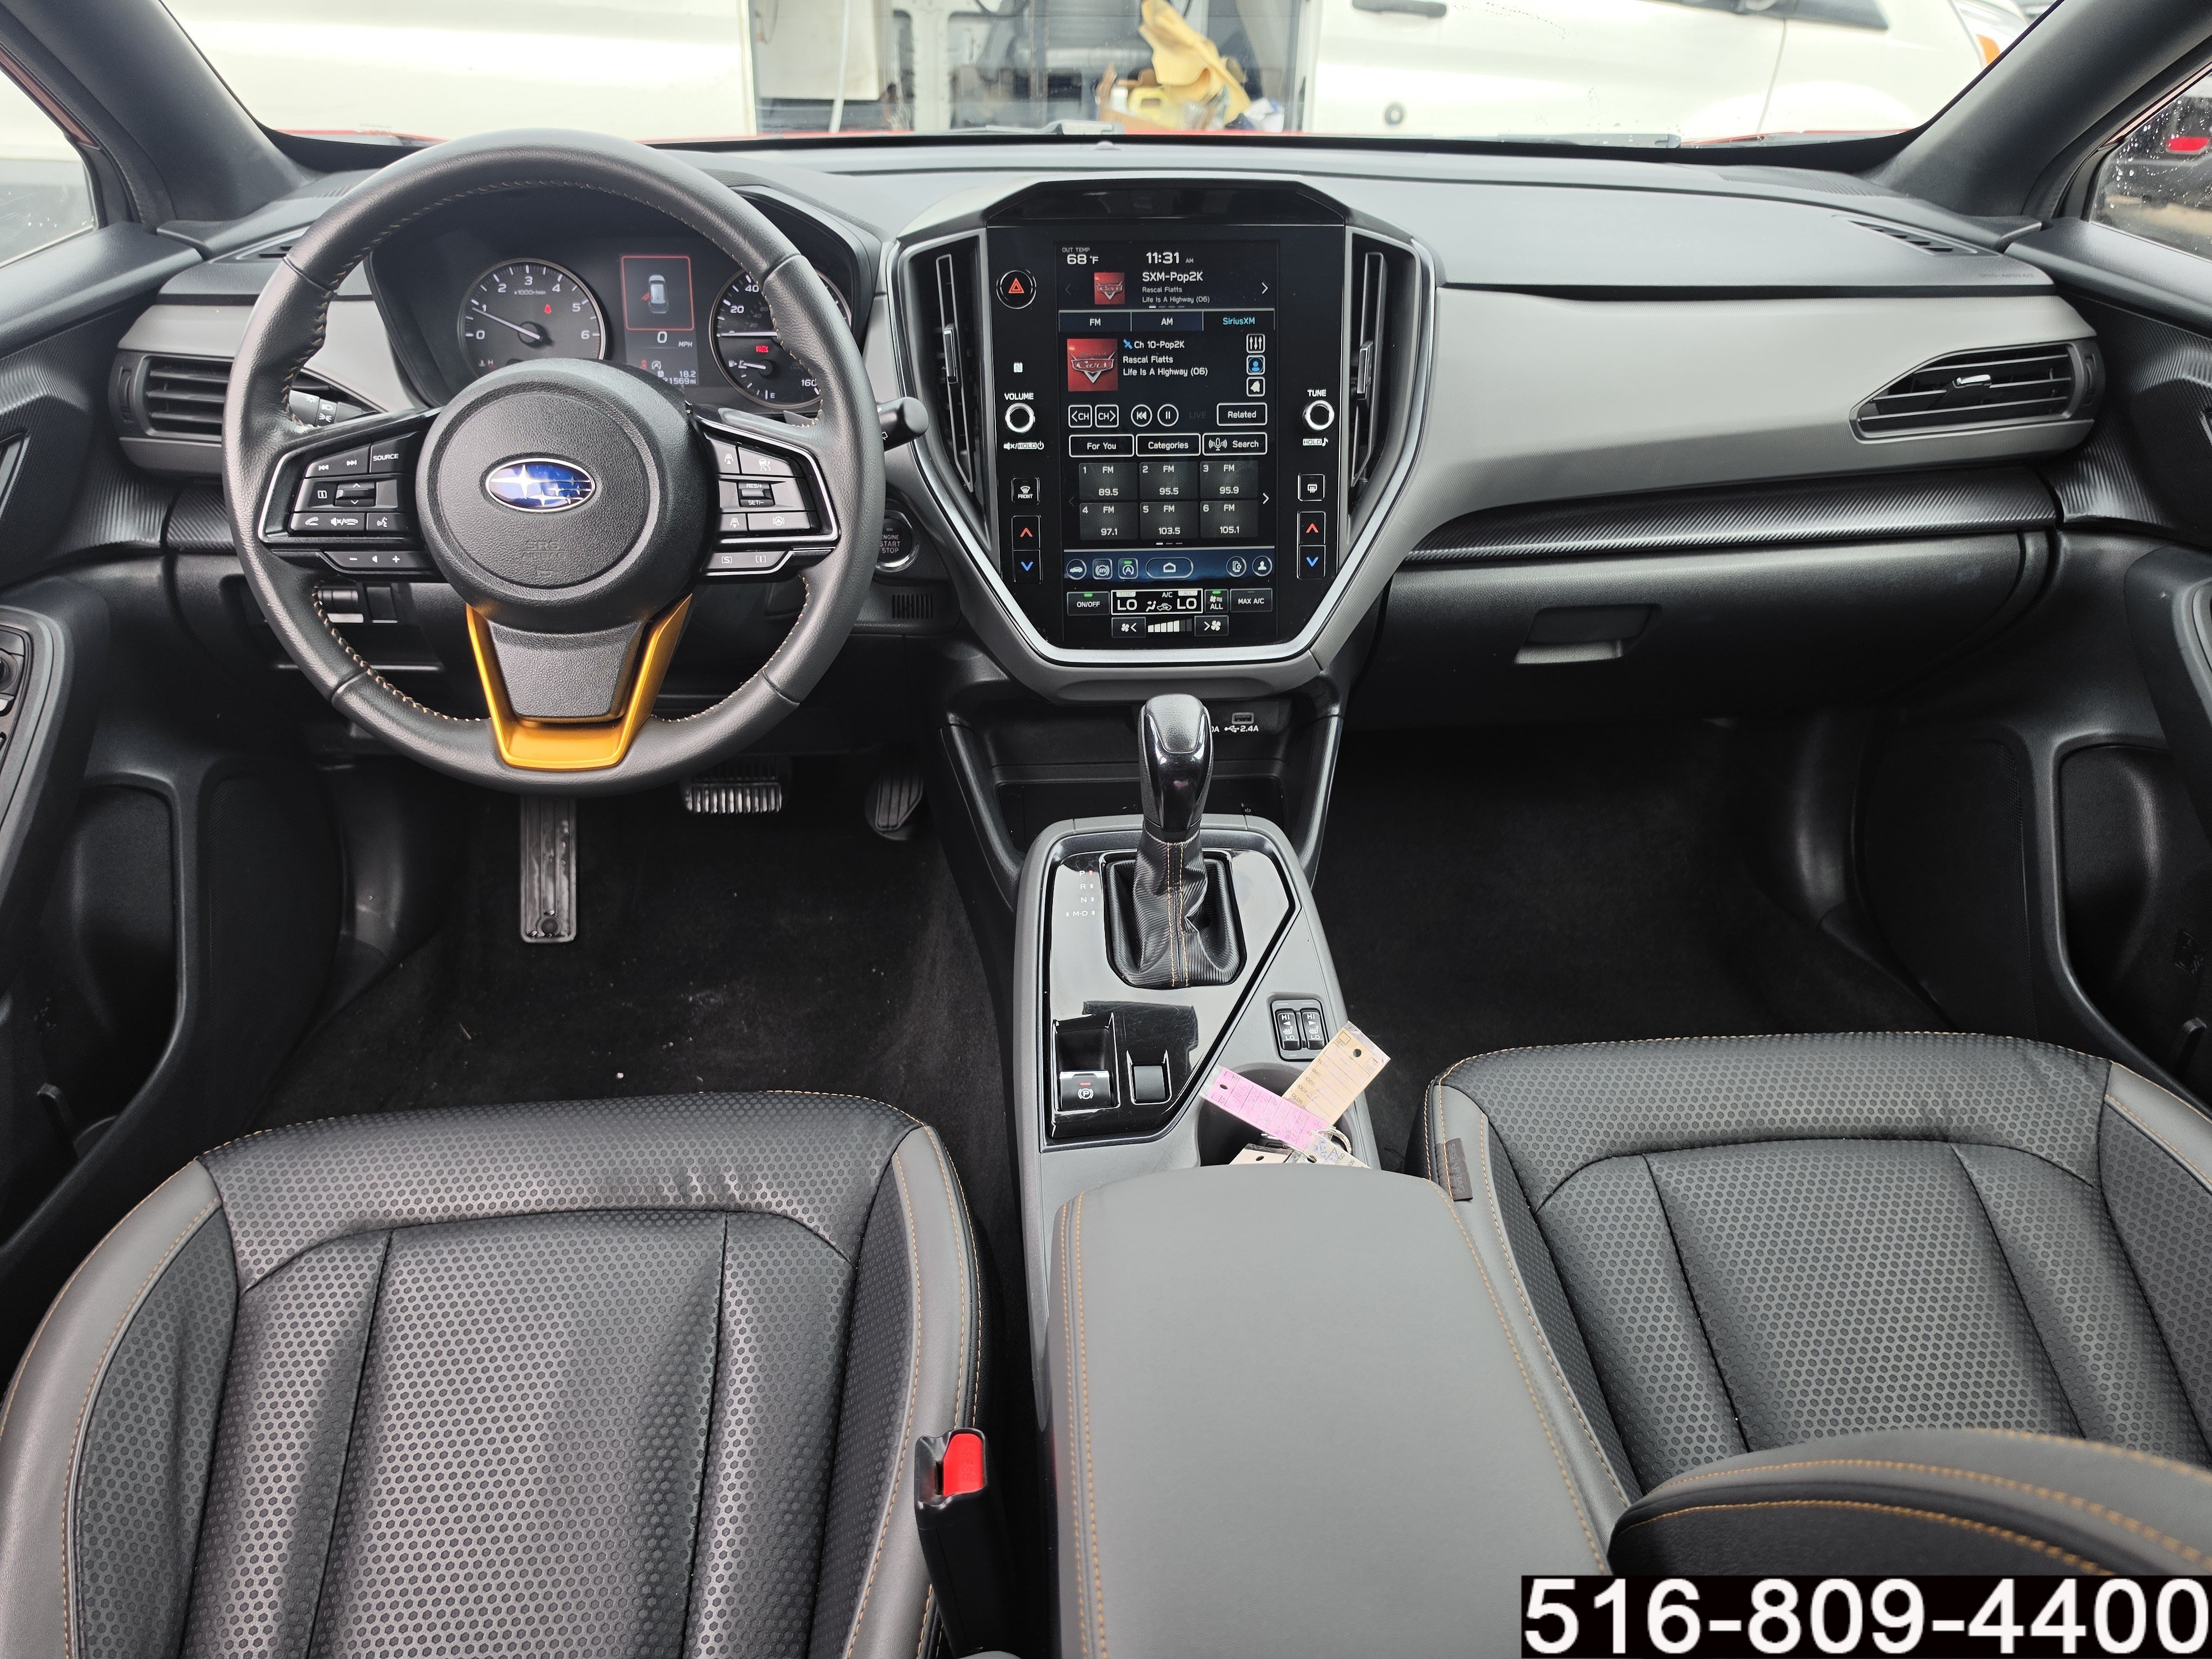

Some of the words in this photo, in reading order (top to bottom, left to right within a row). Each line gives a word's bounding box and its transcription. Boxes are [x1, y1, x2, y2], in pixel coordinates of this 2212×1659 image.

[1067, 254, 1087, 265] 68
[1146, 252, 1180, 264] 11:31
[525, 276, 533, 285] 3
[1142, 272, 1203, 283] SXM-Pop2K
[498, 283, 507, 293] 2
[552, 284, 561, 293] 4
[572, 303, 581, 312] 5
[730, 305, 744, 314] 20
[1089, 318, 1101, 326] FM
[1161, 317, 1173, 326] AM
[1223, 317, 1255, 325] SiriusXM
[476, 330, 486, 340] 0
[581, 330, 590, 340] 6
[657, 331, 667, 343] 0
[1134, 341, 1144, 349] Ch
[1147, 341, 1185, 350] 10-Pop2K
[1123, 356, 1149, 364] Rascal
[1151, 356, 1173, 364] Flatts
[1123, 368, 1139, 377] Life
[1140, 368, 1147, 376] Is
[1149, 368, 1156, 376] A
[1157, 368, 1188, 378] Highway
[1191, 368, 1208, 377] (06)
[1307, 389, 1327, 397] TUNE
[1228, 410, 1257, 419] Related
[1087, 442, 1100, 451] For
[1103, 442, 1117, 451] You
[1148, 441, 1189, 451] Categories
[1232, 440, 1259, 448] Search
[373, 453, 399, 461] SOURCE
[1163, 465, 1175, 473] FM
[1098, 488, 1119, 497] 89.5
[1159, 487, 1179, 495] 95.5
[1219, 486, 1239, 495] 95.9
[1163, 505, 1175, 513] FM
[1223, 504, 1235, 512] FM
[1100, 528, 1118, 536] 97.1
[1159, 526, 1181, 535] 103.5
[1219, 526, 1240, 534] 105.1
[1117, 599, 1138, 611] LO
[1177, 598, 1197, 609] LO
[1334, 1039, 1345, 1047] NEW
